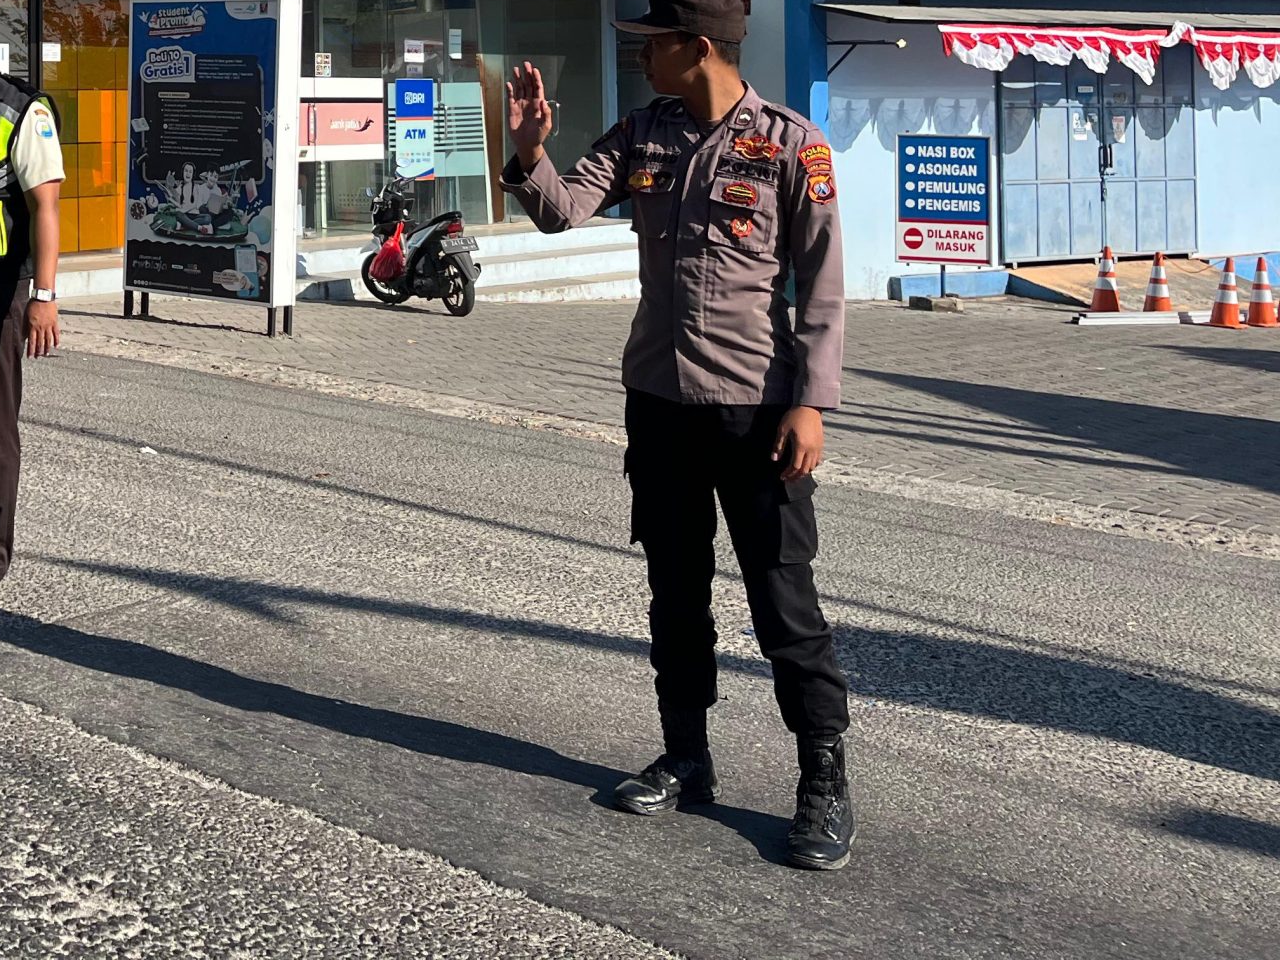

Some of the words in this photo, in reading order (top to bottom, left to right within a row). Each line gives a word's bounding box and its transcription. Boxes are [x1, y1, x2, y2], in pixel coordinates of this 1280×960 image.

[150, 51, 168, 63] Beli
[169, 49, 181, 60] 10
[144, 63, 184, 77] Gratis
[412, 93, 424, 104] BRI
[404, 129, 426, 139] ATM
[917, 145, 946, 158] NASI
[950, 147, 975, 159] BOX
[917, 163, 977, 176] ASONGAN
[917, 181, 986, 194] PEMULUNG
[917, 198, 981, 212] PENGEMIS
[927, 229, 984, 241] DILARANG
[935, 242, 976, 252] MASUK
